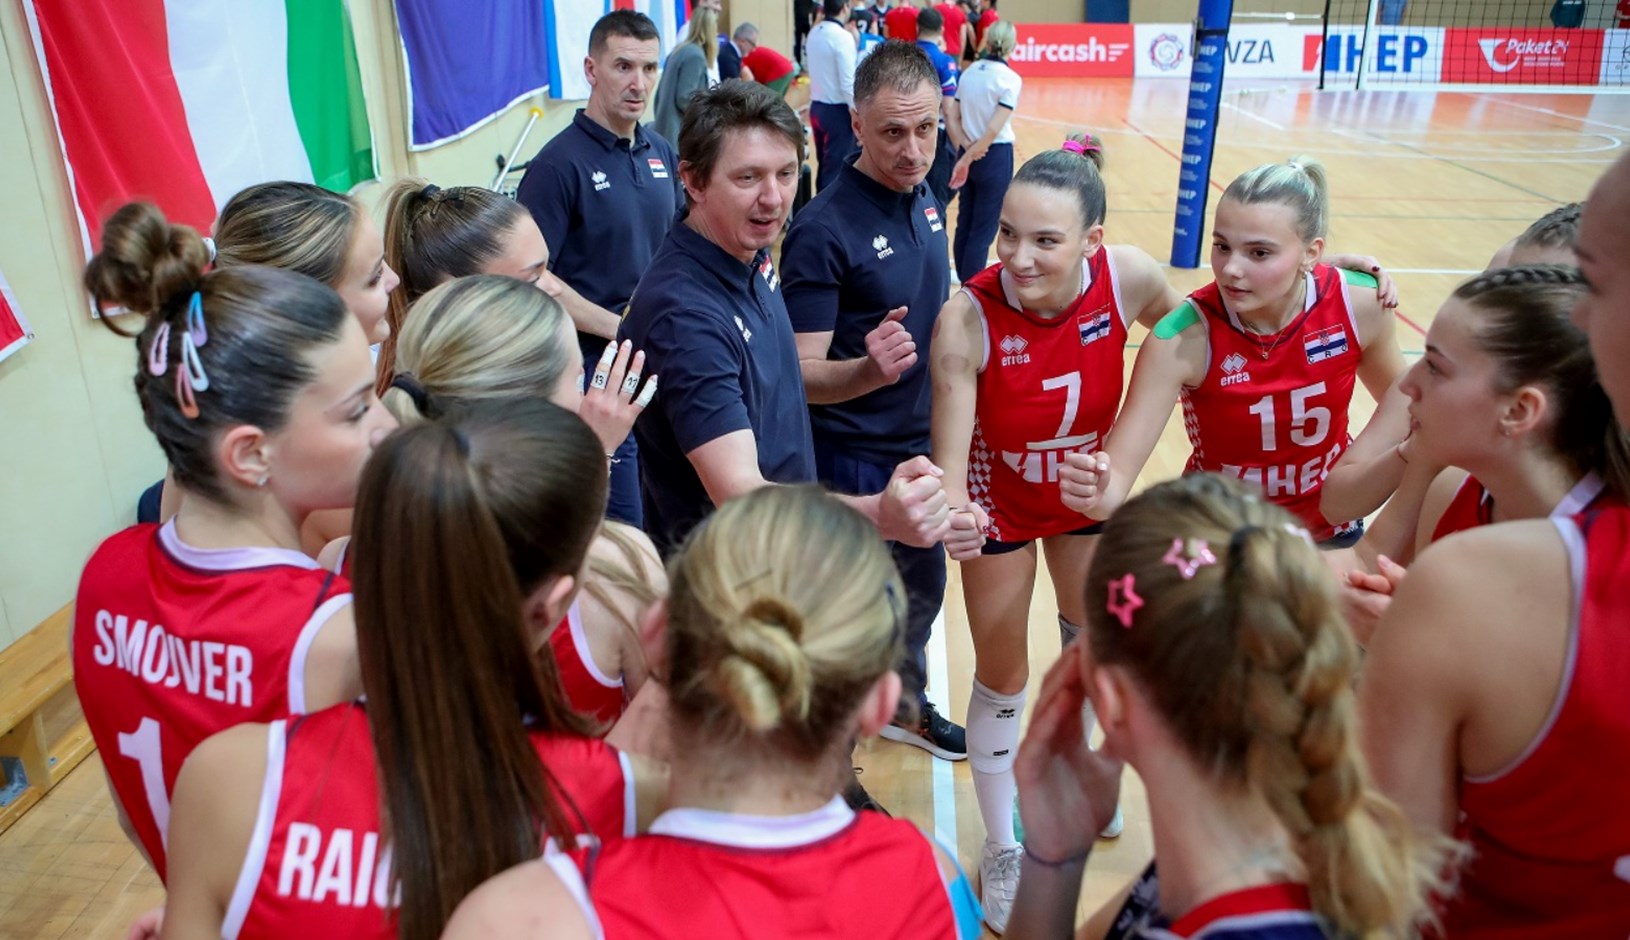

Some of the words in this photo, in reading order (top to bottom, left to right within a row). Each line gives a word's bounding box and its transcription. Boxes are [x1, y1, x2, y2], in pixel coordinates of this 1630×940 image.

[1011, 37, 1106, 62] aircash
[1346, 35, 1427, 72] HEP
[1042, 370, 1082, 438] 7
[1249, 380, 1332, 451] 15
[93, 608, 254, 708] SMOJVER
